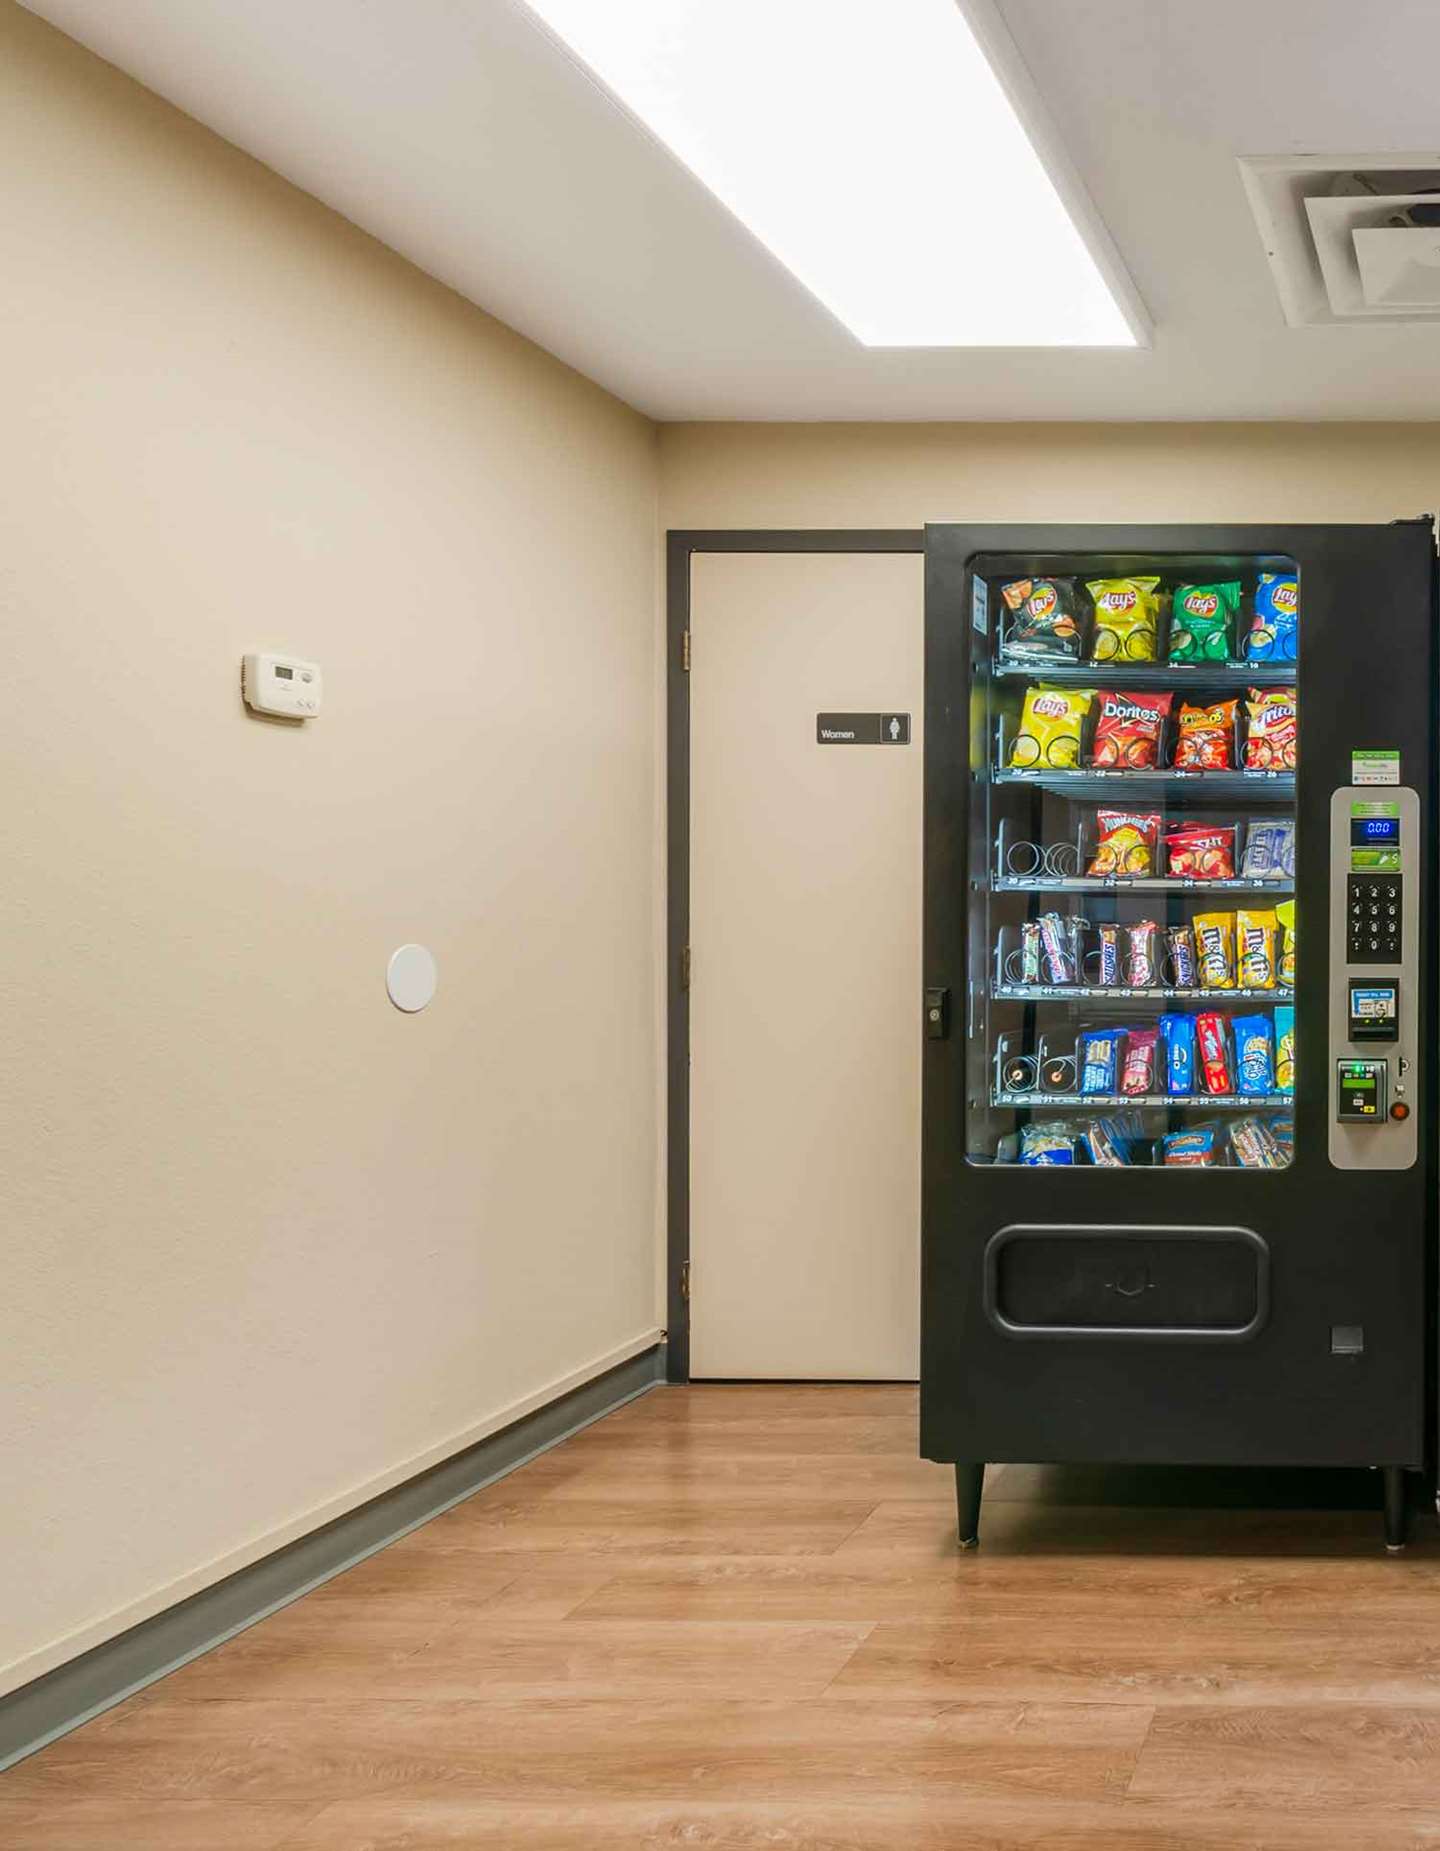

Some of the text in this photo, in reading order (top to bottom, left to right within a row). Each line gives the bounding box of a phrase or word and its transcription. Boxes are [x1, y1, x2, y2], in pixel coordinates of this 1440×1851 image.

[1104, 702, 1161, 724] Doritos
[821, 729, 855, 739] Women
[1355, 887, 1396, 898] 1 2 3
[1353, 905, 1396, 915] 4 5 6
[1354, 922, 1396, 932] 7 8 9
[1371, 940, 1378, 950] 0
[1102, 943, 1115, 986] SATISFIES
